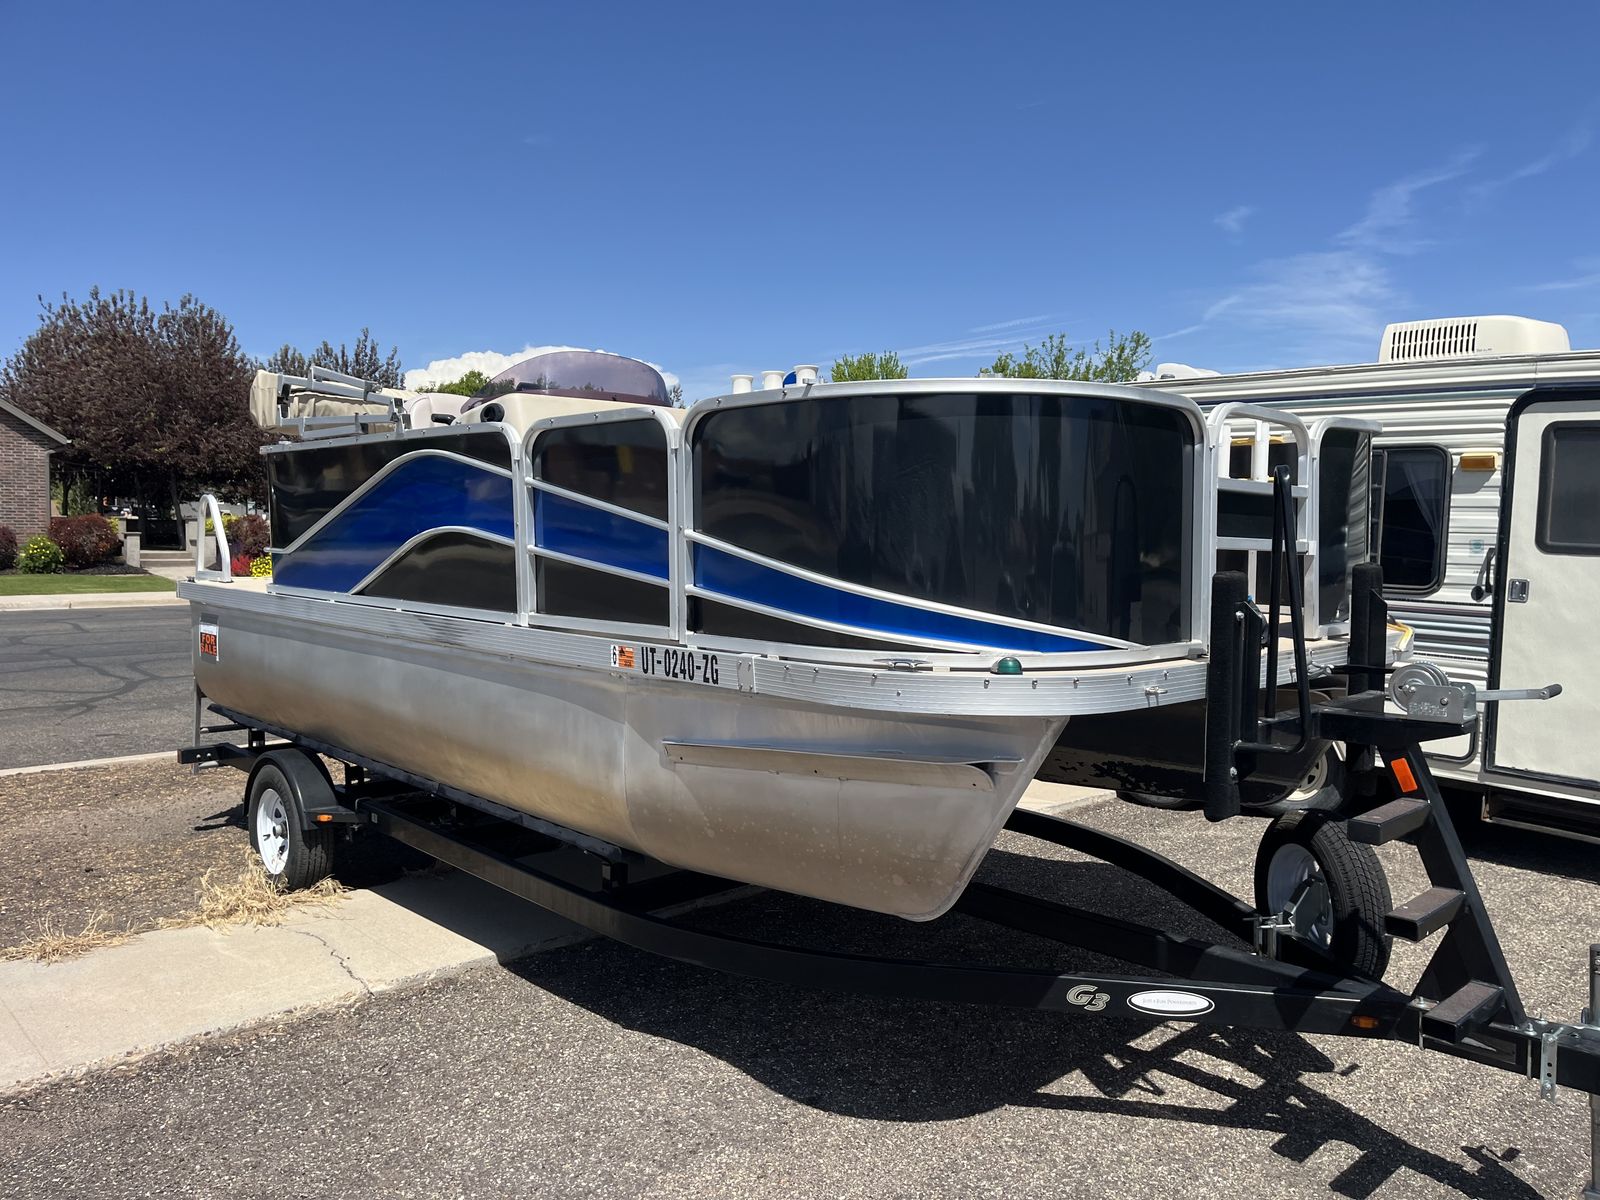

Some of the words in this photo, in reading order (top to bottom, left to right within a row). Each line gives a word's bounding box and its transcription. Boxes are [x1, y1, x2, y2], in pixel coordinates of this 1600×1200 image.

[201, 633, 216, 645] FOR
[201, 643, 217, 656] SALE
[612, 645, 618, 665] 6
[641, 646, 719, 685] UT-0240-ZG
[1066, 984, 1111, 1011] G3
